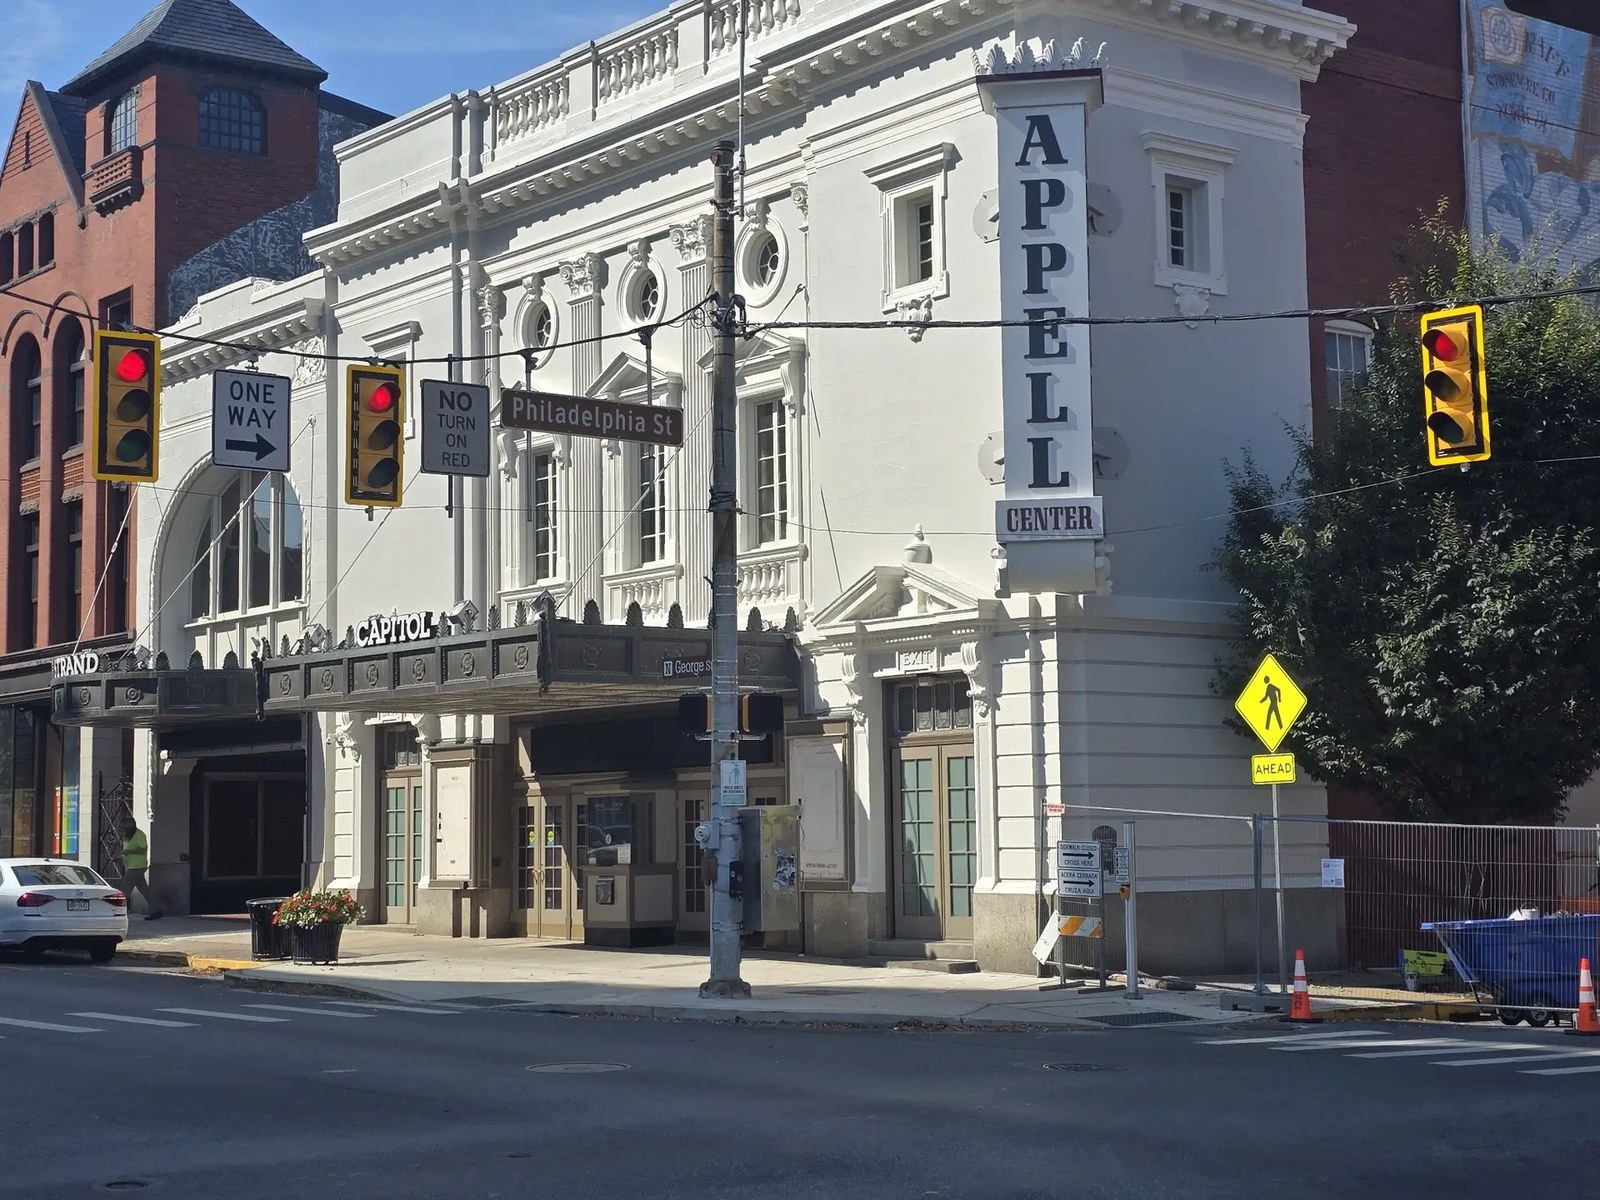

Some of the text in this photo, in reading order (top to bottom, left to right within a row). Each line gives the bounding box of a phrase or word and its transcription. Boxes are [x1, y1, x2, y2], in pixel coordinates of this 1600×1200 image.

[1015, 114, 1070, 489] APPELL
[230, 380, 275, 404] ONE
[439, 390, 473, 412] NO
[228, 405, 277, 429] WAY
[437, 413, 476, 431] TURN
[512, 397, 673, 436] Philadelphia St
[446, 433, 467, 448] ON
[442, 452, 470, 468] RED
[1006, 505, 1093, 532] CENTER
[356, 611, 432, 647] CAPITOL
[664, 660, 713, 676] N George S
[903, 651, 931, 666] EXIT
[1256, 763, 1292, 775] AHEAD
